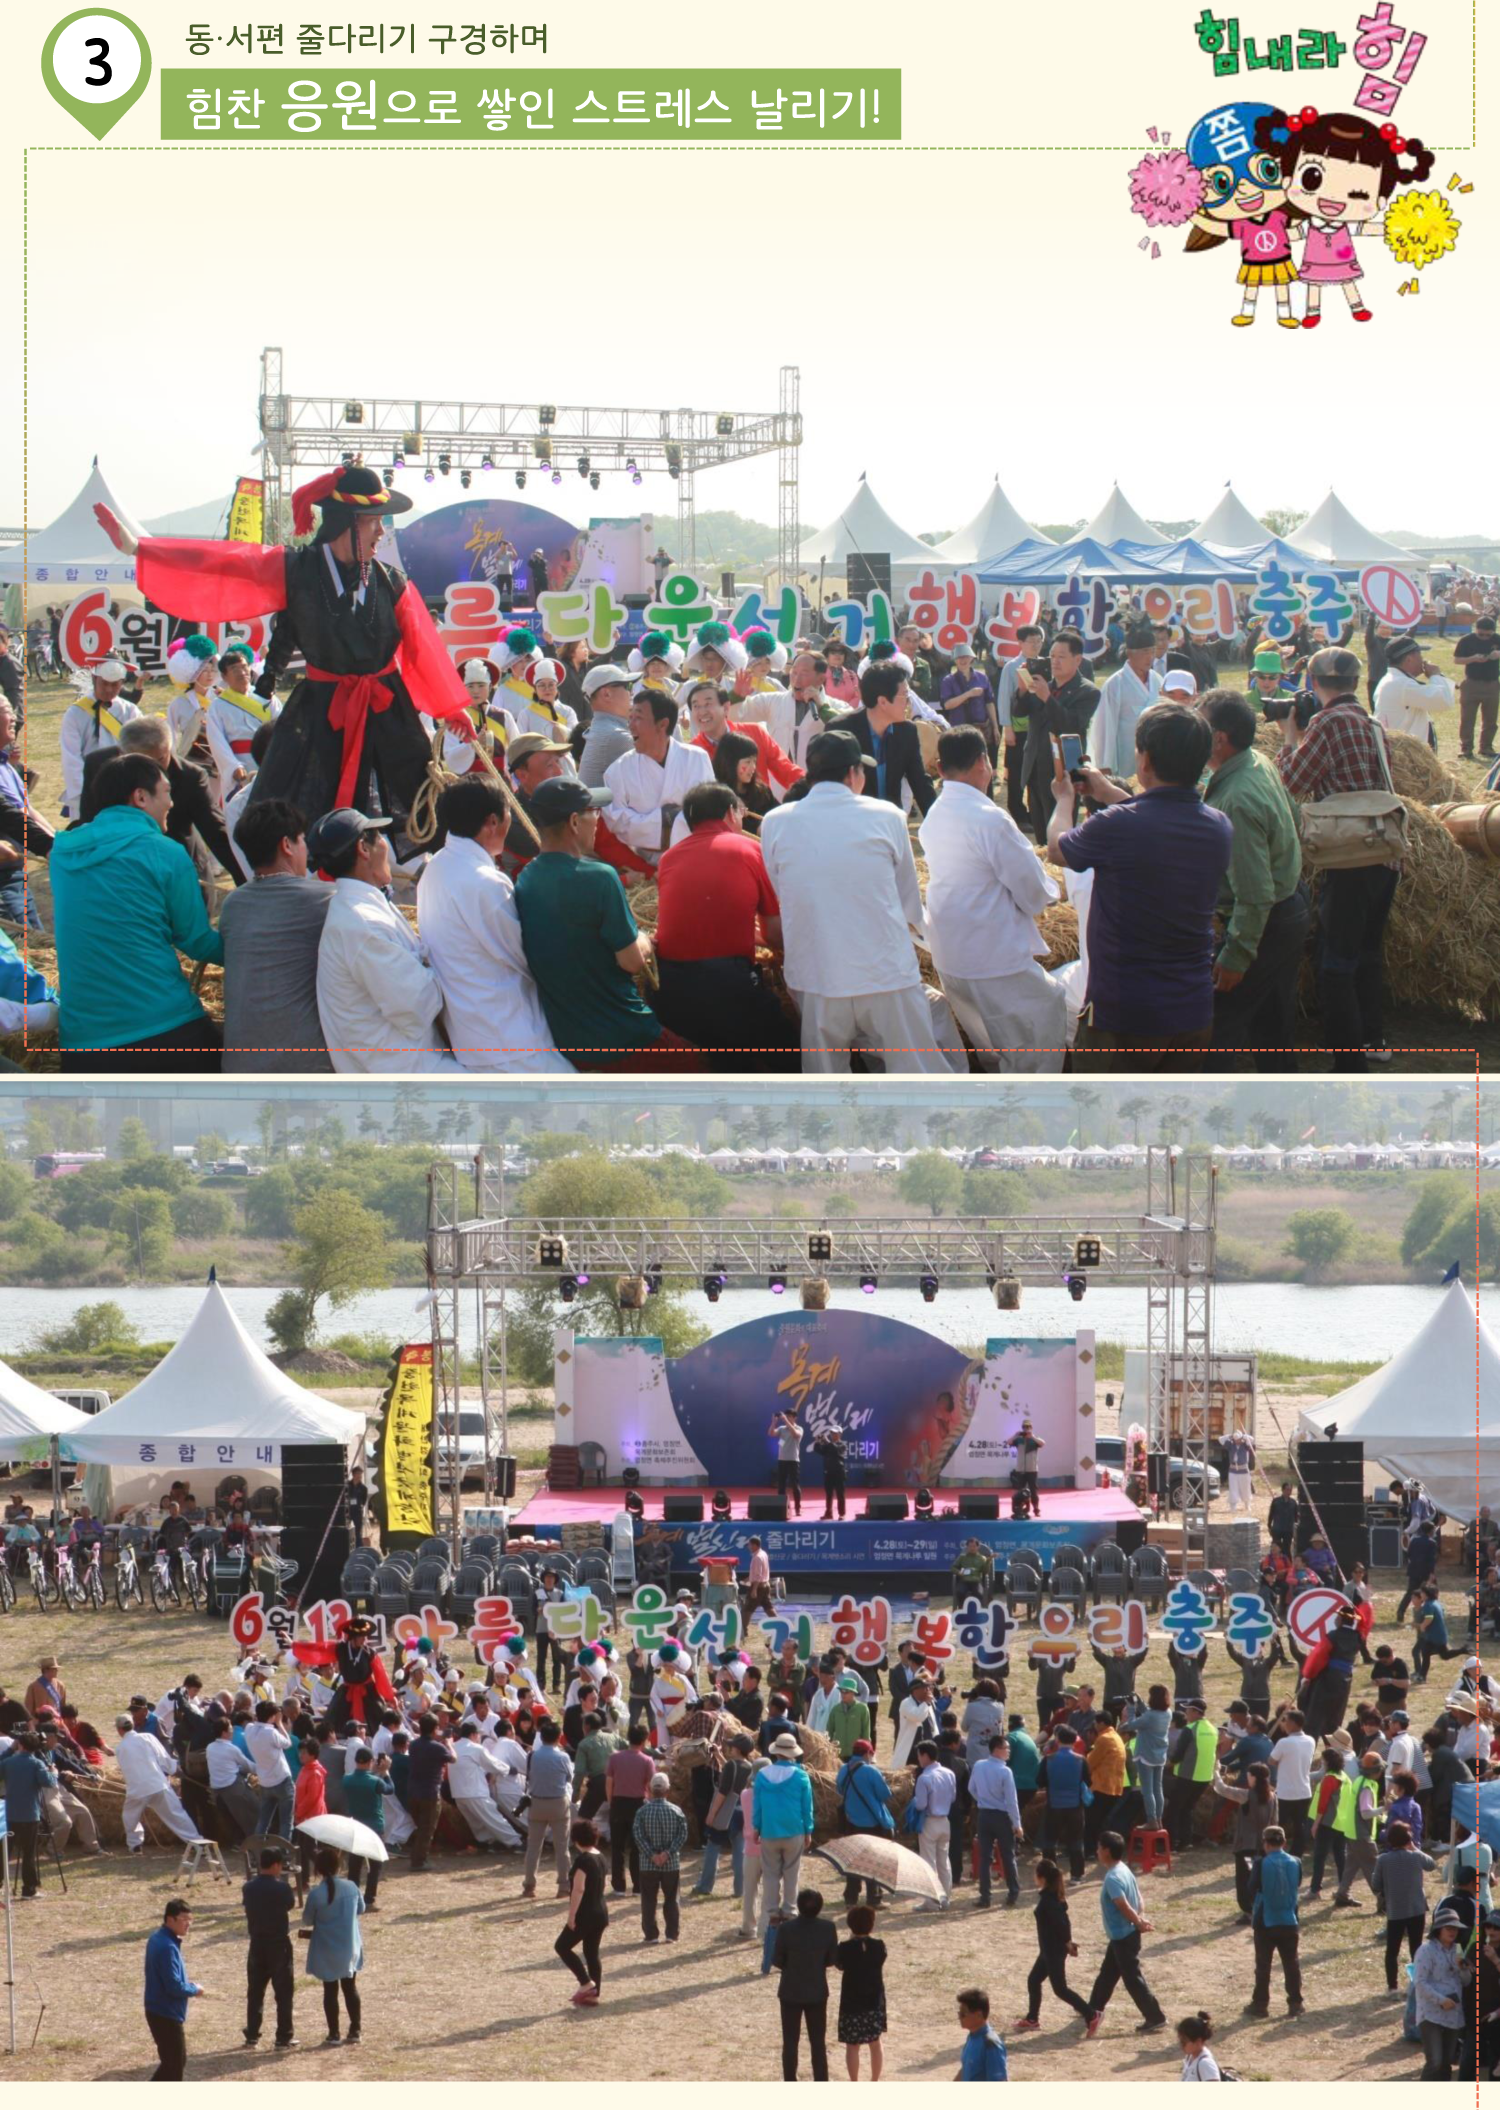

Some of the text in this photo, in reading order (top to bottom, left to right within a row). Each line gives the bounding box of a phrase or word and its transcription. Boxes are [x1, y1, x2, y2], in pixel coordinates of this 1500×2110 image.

[65, 591, 167, 672] 6월
[1253, 560, 1353, 639] 충주
[138, 1444, 273, 1463] 종합안내
[766, 1530, 836, 1550] 줄다리기
[232, 1595, 296, 1650] 6월
[1031, 1603, 1144, 1663] 우리
[1161, 1584, 1274, 1655] 충주
